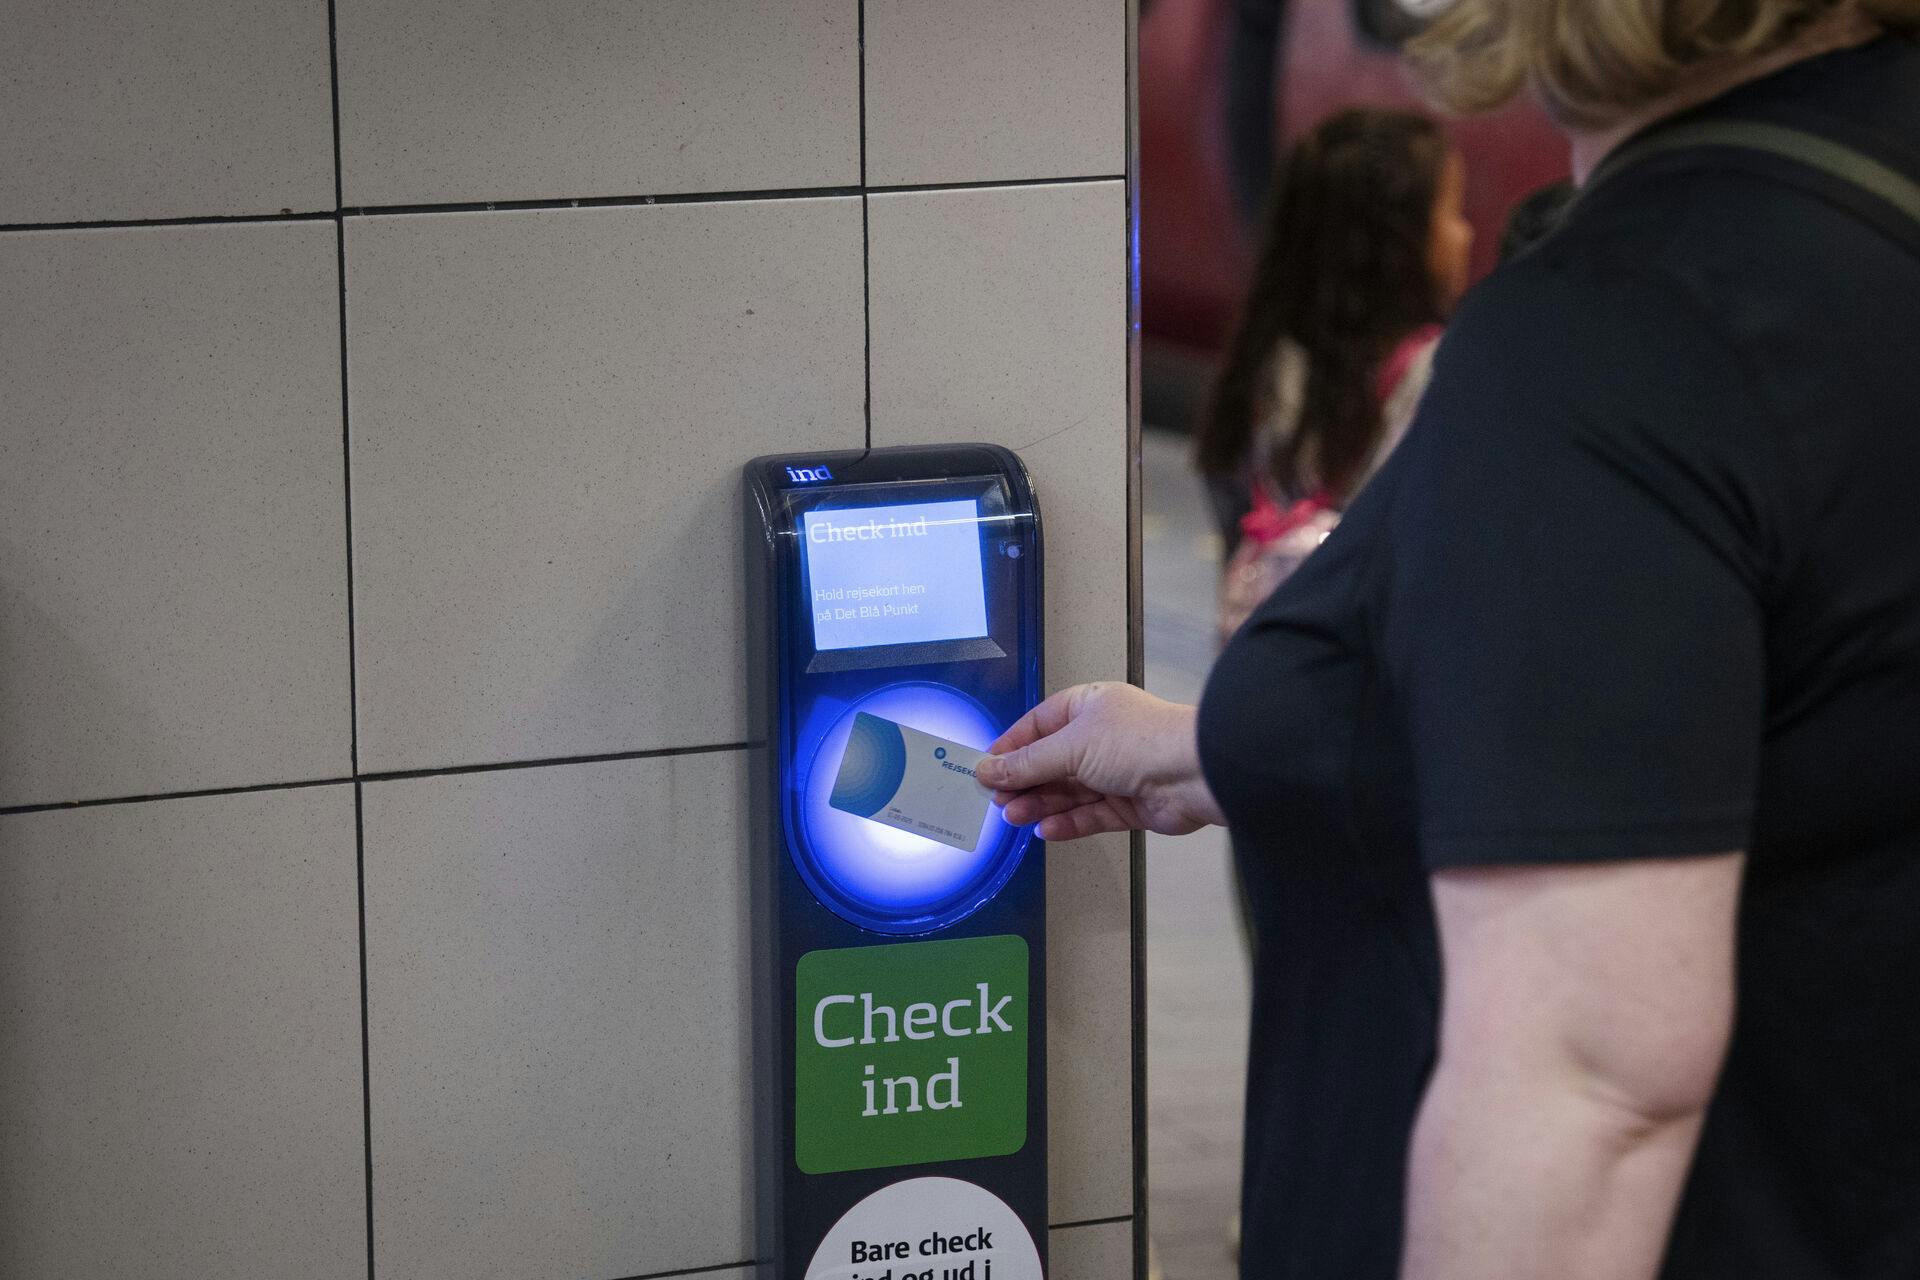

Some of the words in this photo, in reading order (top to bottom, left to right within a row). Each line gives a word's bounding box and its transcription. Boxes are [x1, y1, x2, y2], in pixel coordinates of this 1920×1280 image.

[786, 465, 833, 483] ind
[809, 520, 884, 543] Check
[890, 517, 928, 538] ind
[815, 588, 843, 601] Hold
[847, 584, 898, 600] rejsekort
[902, 583, 925, 594] hen
[817, 609, 832, 624] på
[835, 608, 856, 620] Det
[860, 605, 880, 618] Blå
[884, 603, 919, 616] Punkt
[813, 983, 1013, 1048] Check
[861, 1057, 963, 1117] ind
[851, 1241, 910, 1264] Bare
[918, 1227, 993, 1256] check
[943, 1260, 975, 1280] ud
